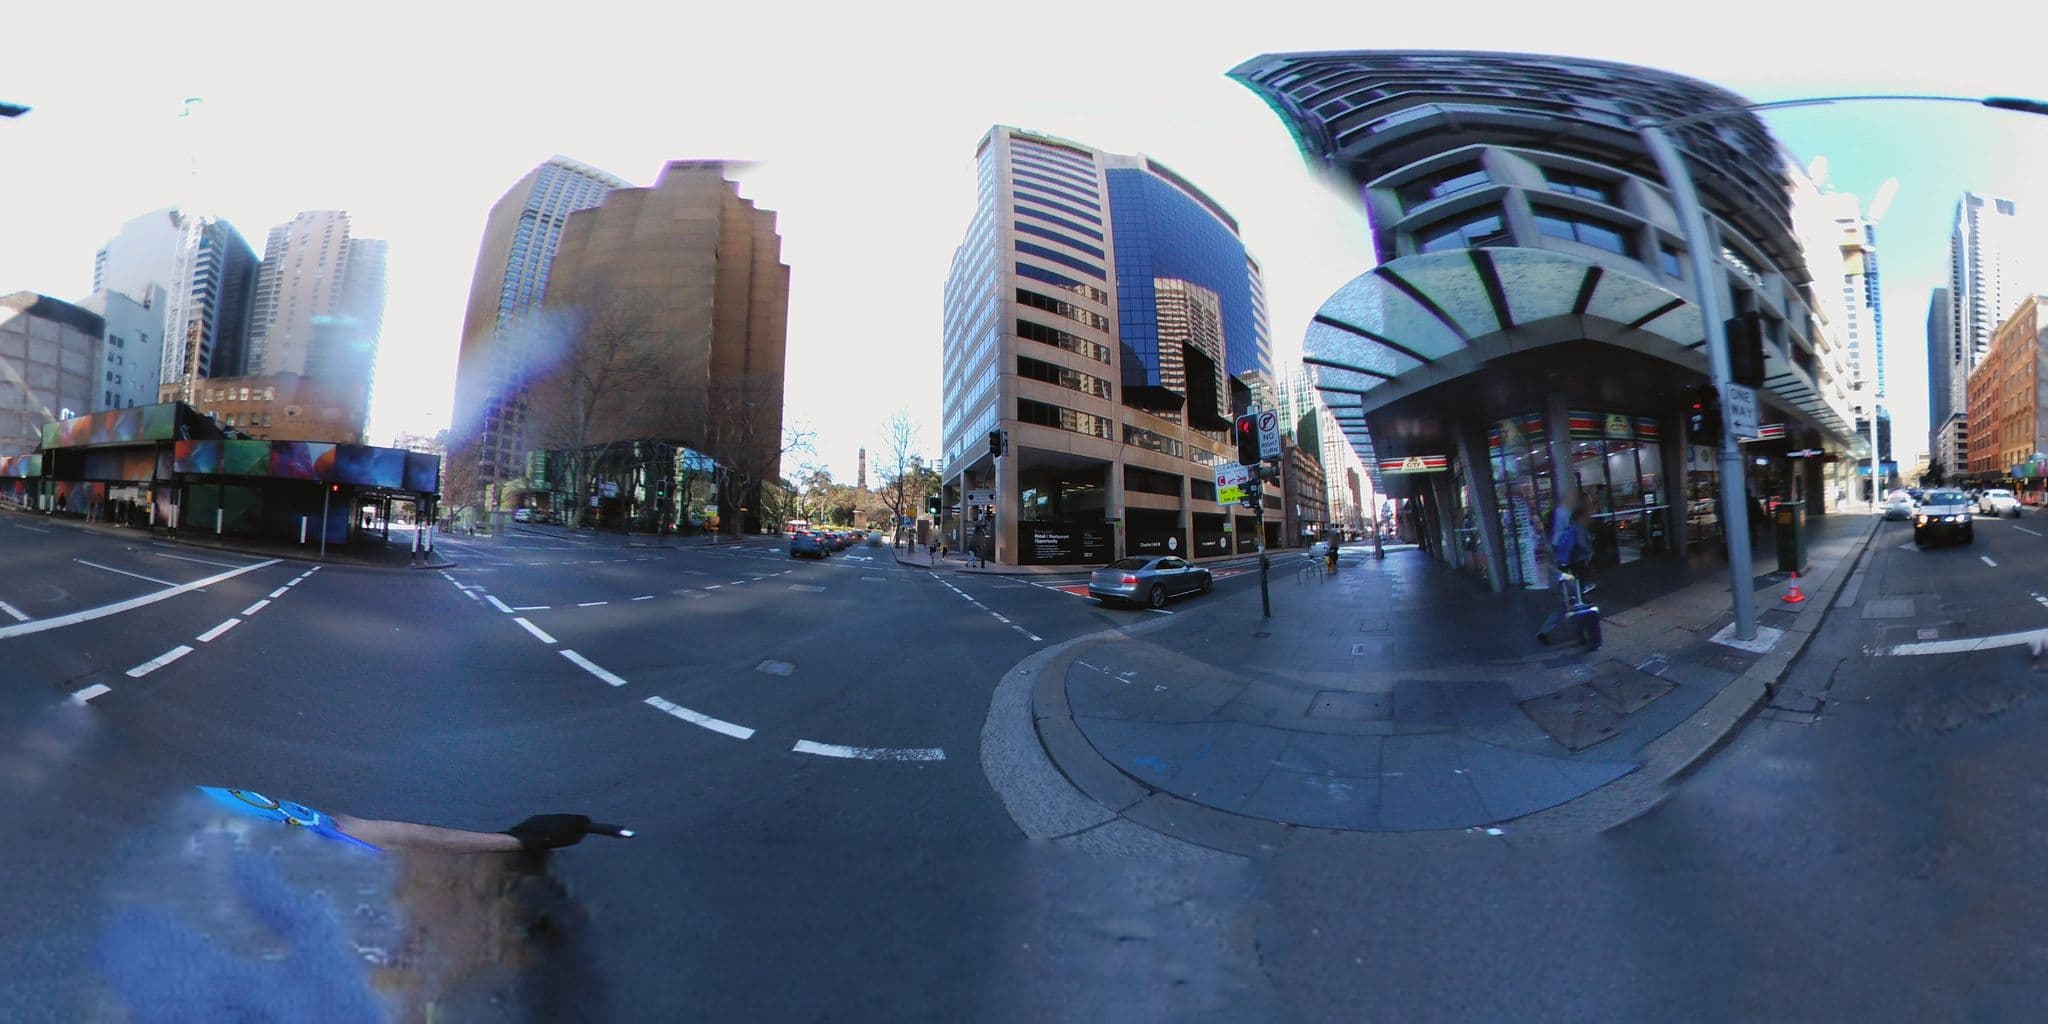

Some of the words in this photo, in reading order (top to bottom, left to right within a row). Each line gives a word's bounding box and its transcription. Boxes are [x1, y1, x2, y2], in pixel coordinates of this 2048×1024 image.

[1730, 388, 1751, 403] ONE
[1731, 404, 1752, 418] WAY
[1263, 433, 1275, 441] NO
[1263, 447, 1278, 455] TURN
